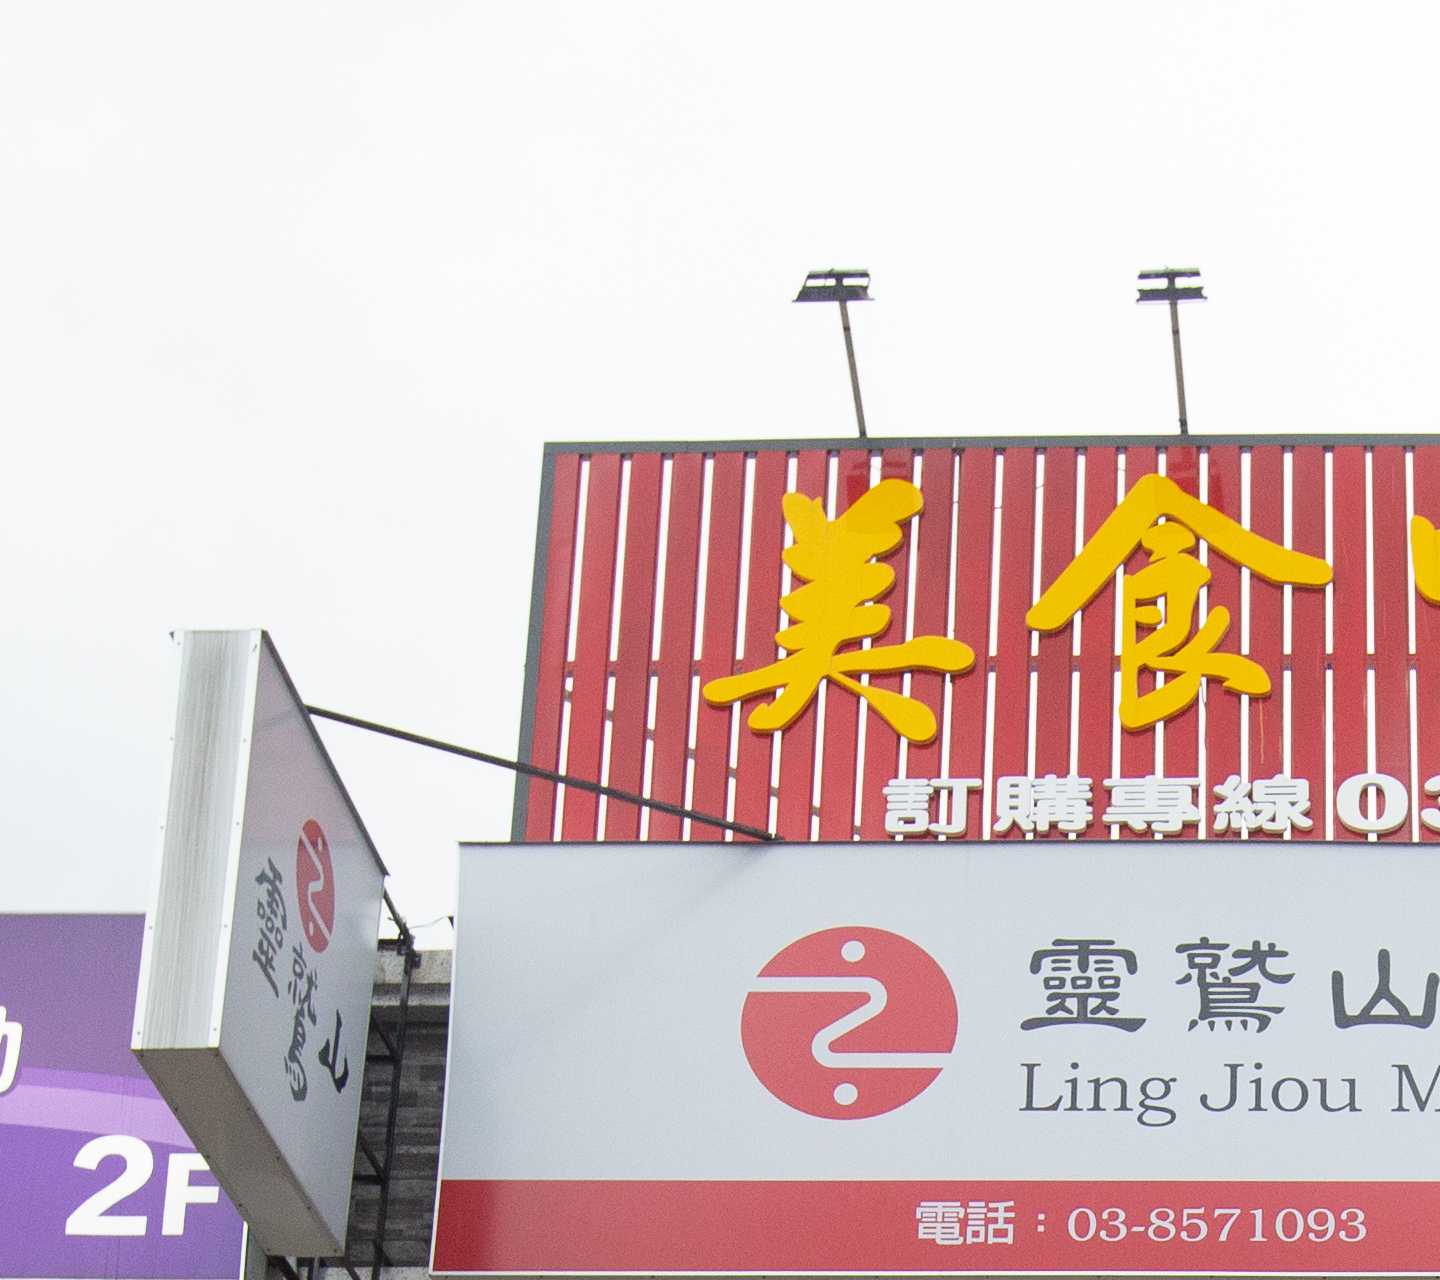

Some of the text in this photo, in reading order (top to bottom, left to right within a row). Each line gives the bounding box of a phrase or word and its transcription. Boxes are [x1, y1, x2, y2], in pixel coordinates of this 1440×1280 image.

[1019, 1062, 1177, 1127] Ling
[1199, 1062, 1363, 1114] Jiou
[64, 1133, 219, 1237] 2F
